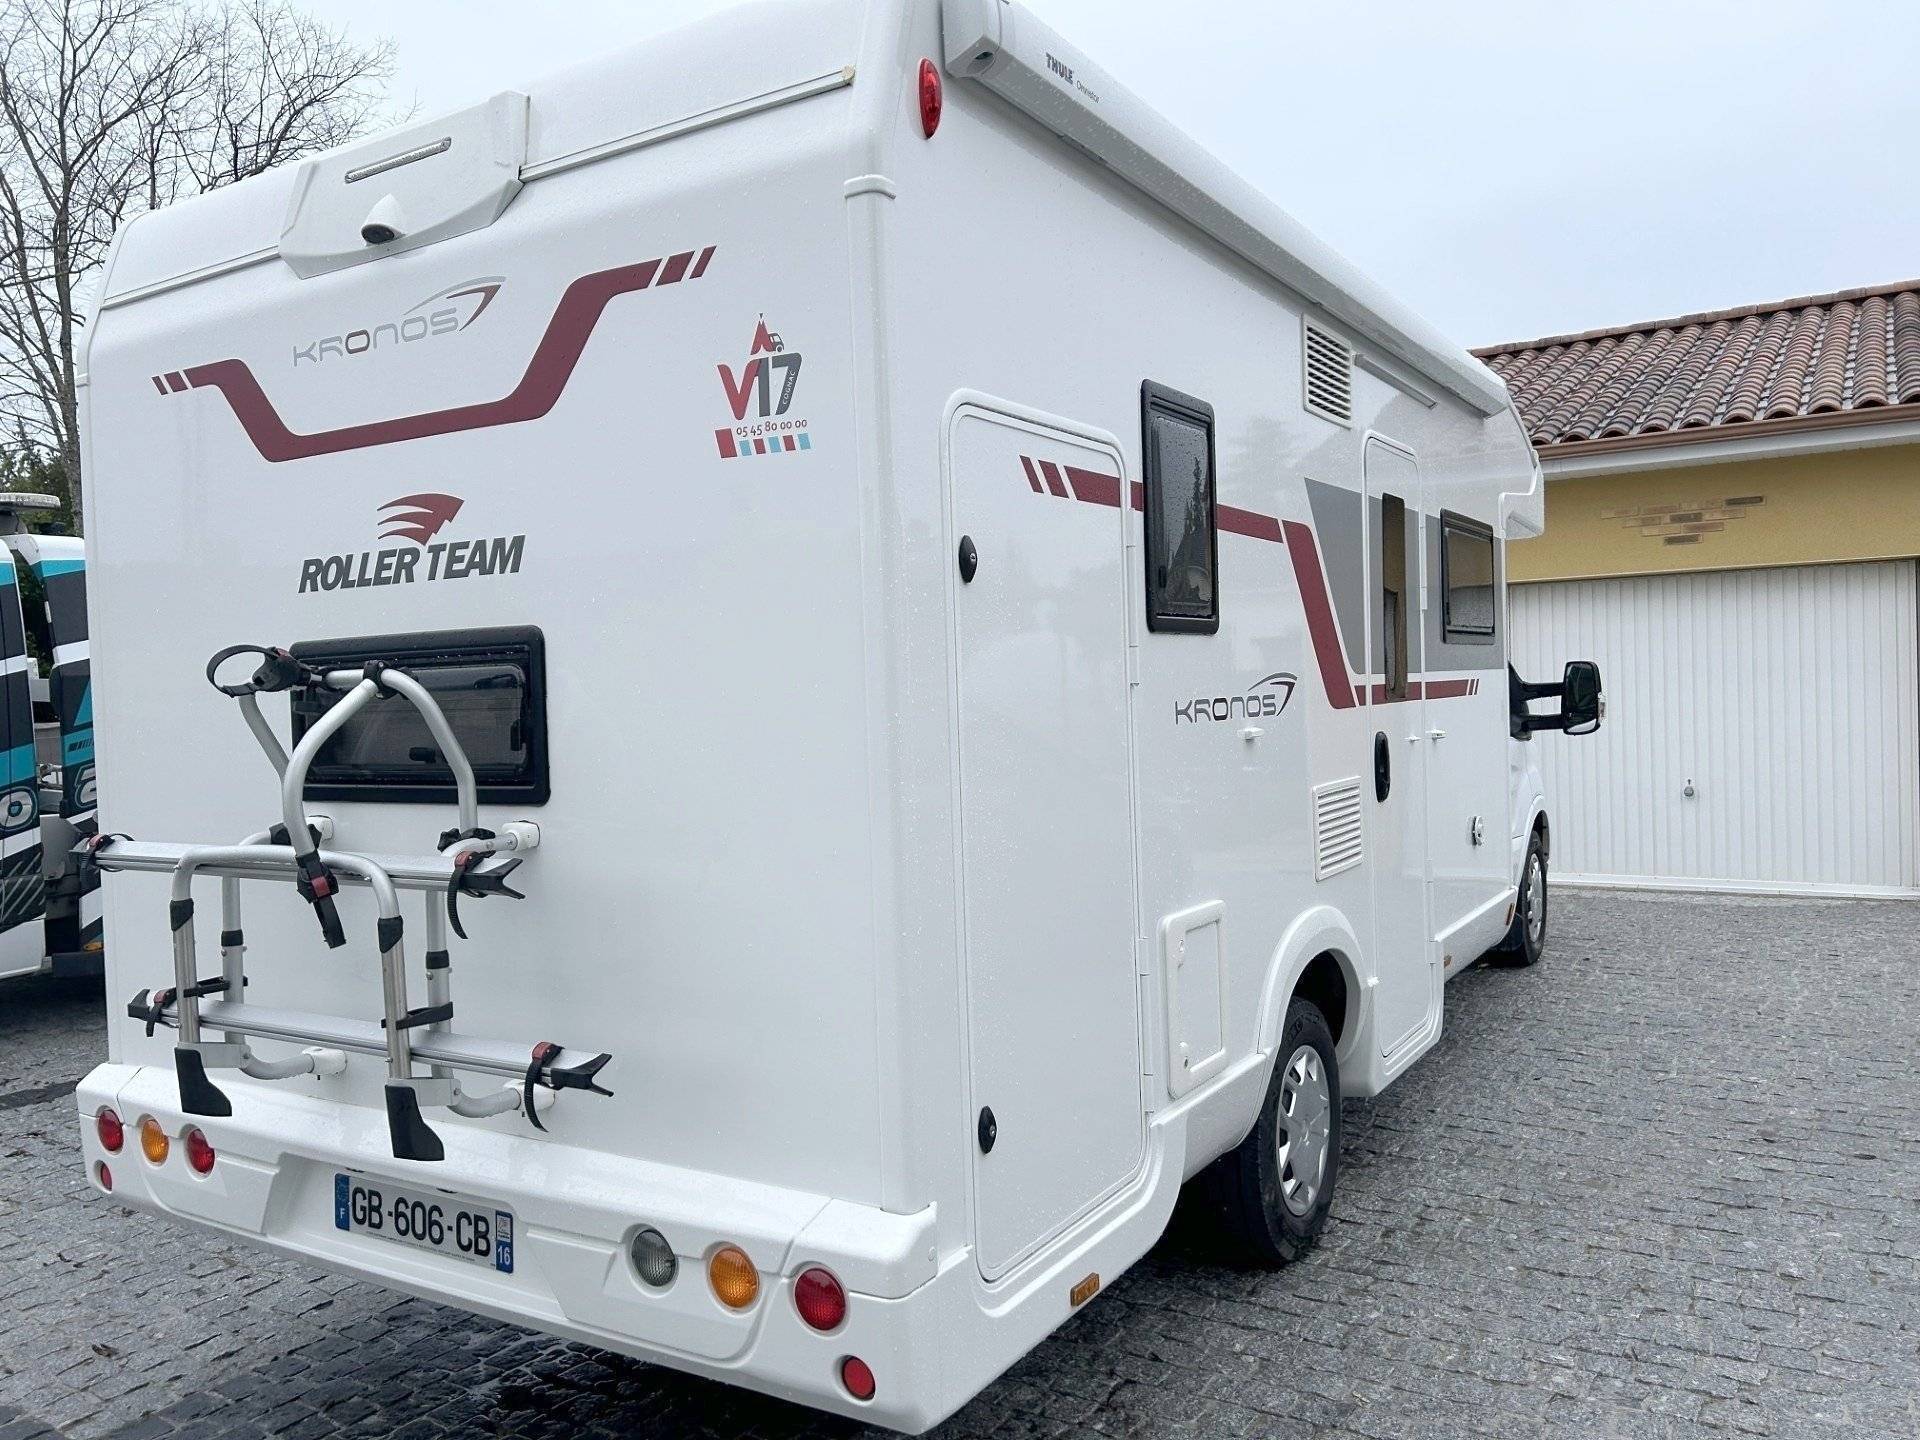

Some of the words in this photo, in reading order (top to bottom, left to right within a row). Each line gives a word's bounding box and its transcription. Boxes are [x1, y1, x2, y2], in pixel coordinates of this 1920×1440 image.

[1045, 52, 1073, 85] THULE
[293, 307, 459, 367] KRONOS
[736, 426, 748, 437] 05
[750, 424, 763, 436] 45
[765, 421, 778, 431] 80
[780, 421, 793, 430] 00
[794, 419, 808, 429] 00
[298, 547, 421, 593] ROLLER
[427, 534, 526, 581] TEAM
[1175, 694, 1277, 725] KRONOS
[340, 1207, 346, 1219] F
[351, 1186, 491, 1257] GB-606-CB
[497, 1245, 511, 1266] 16
